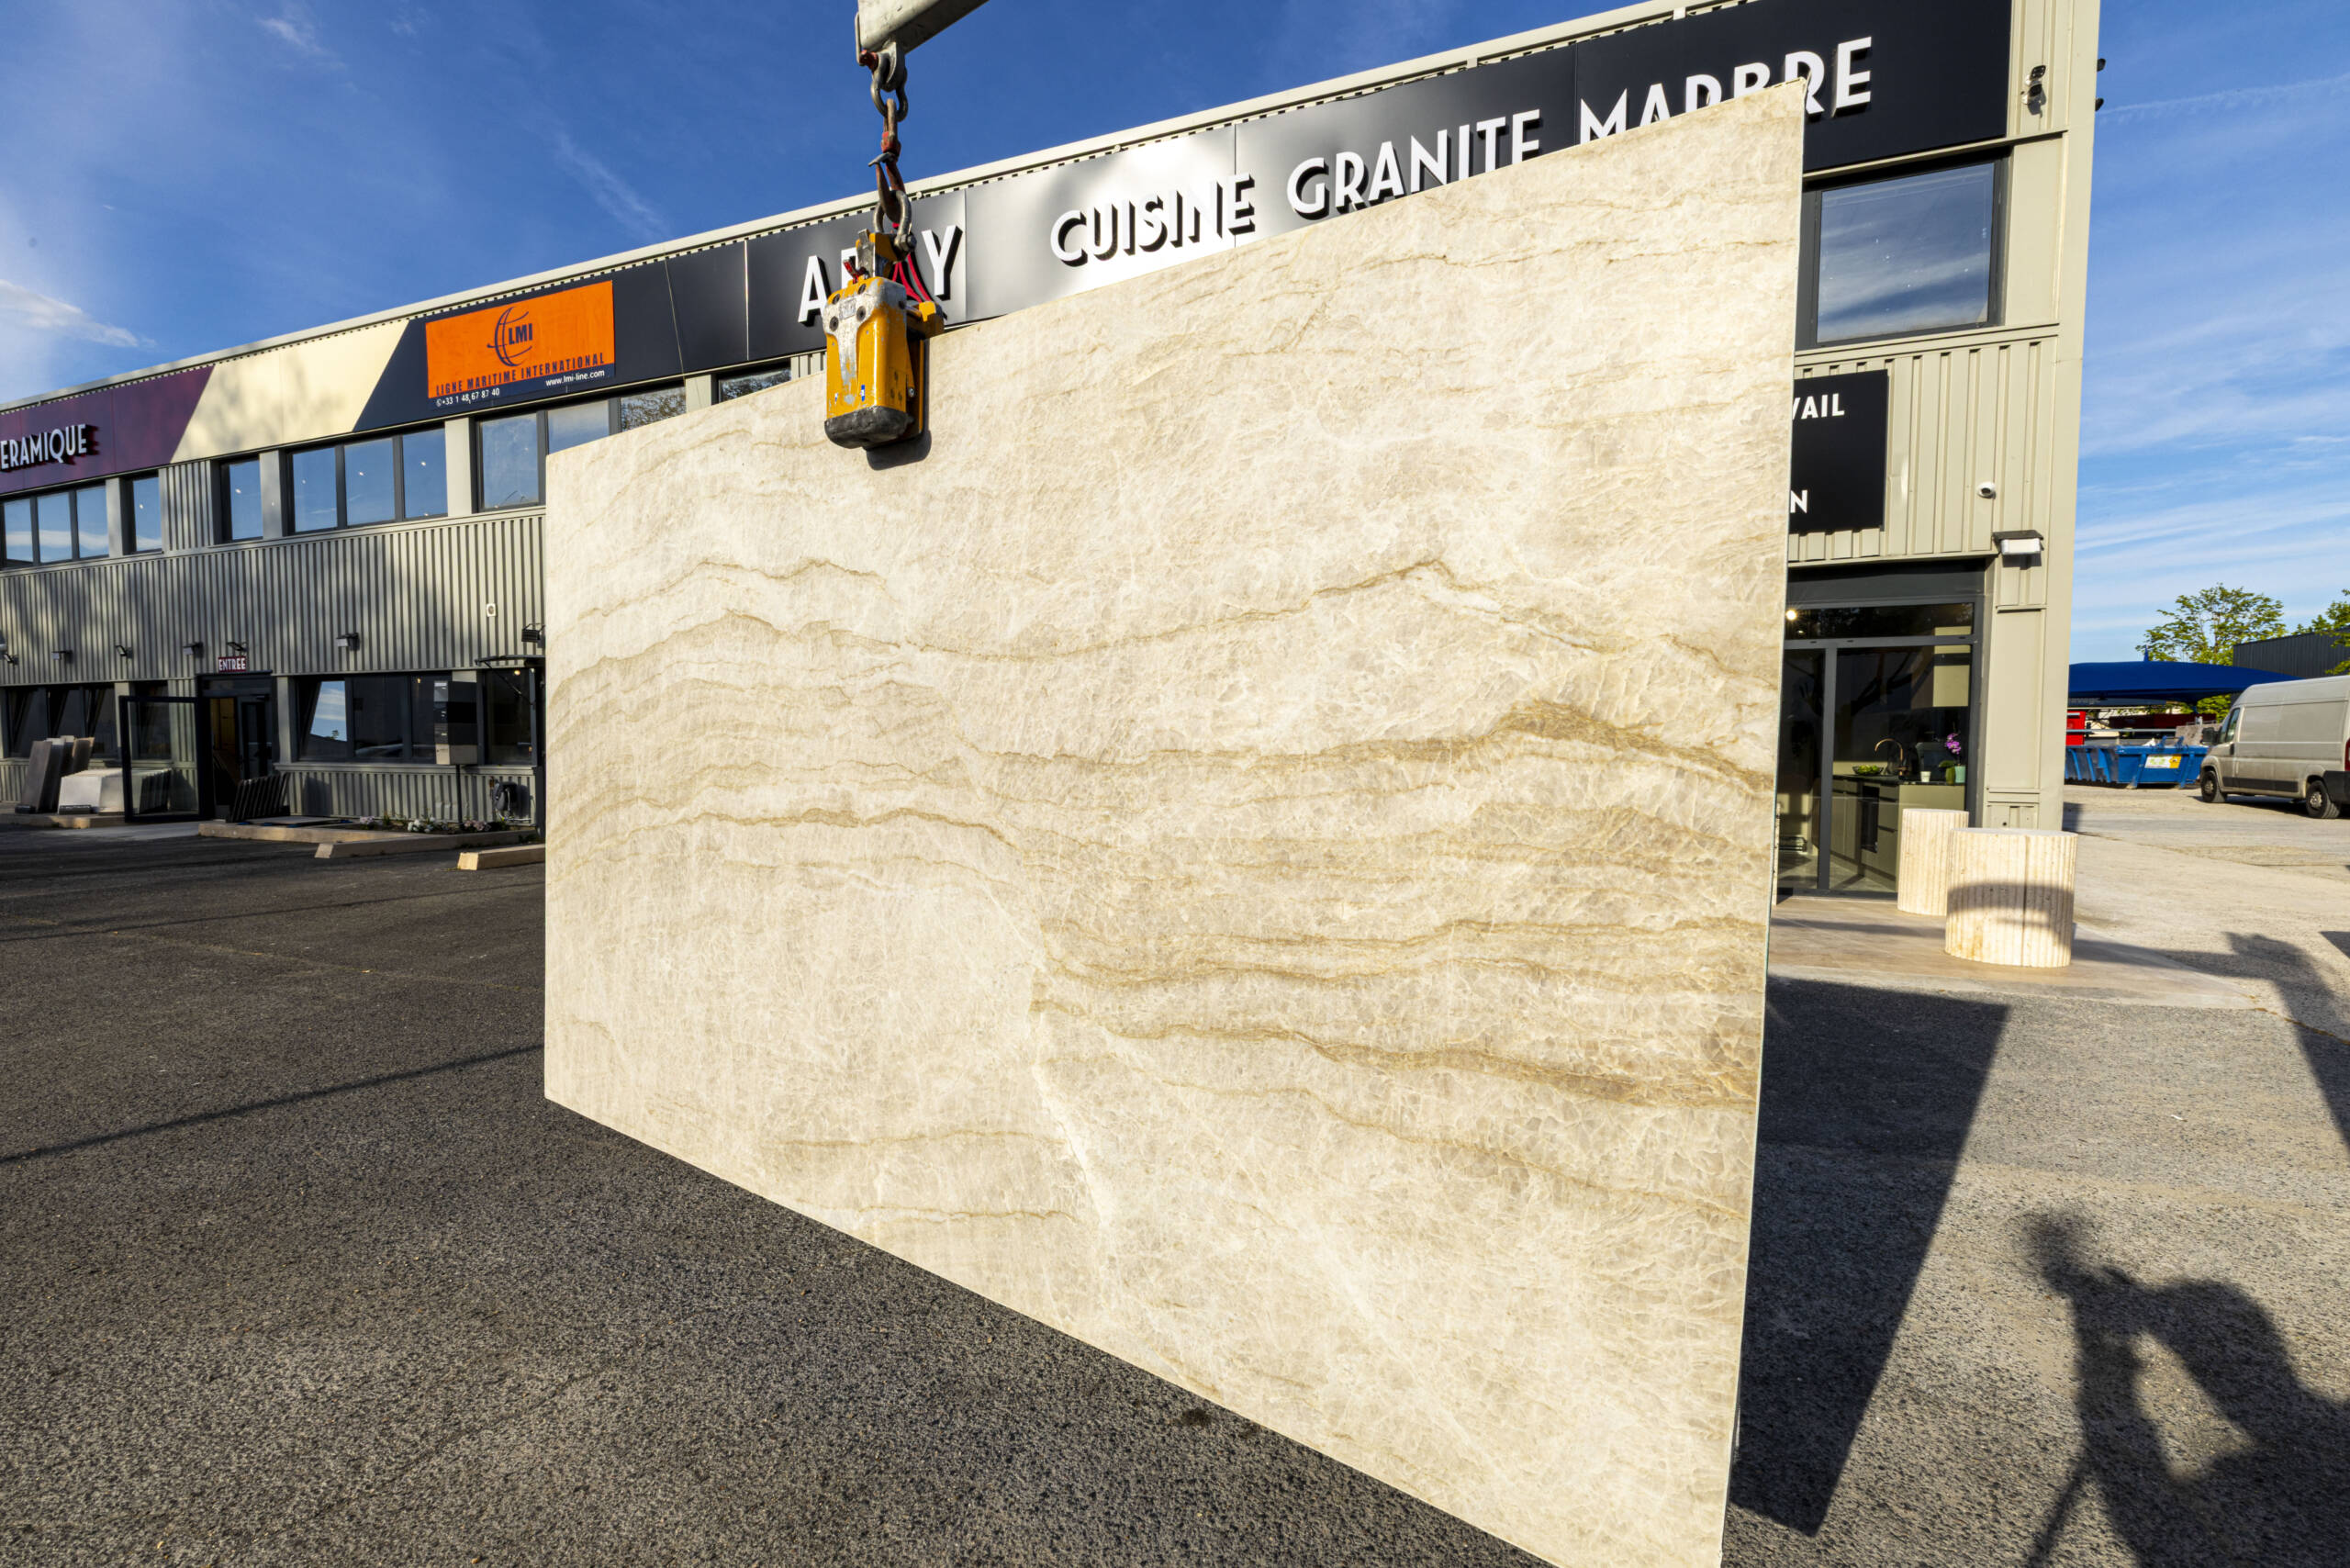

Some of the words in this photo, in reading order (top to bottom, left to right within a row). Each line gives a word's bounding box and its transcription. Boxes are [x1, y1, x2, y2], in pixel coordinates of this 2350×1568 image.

[798, 225, 964, 327] AY
[1050, 173, 1256, 267] CUISINE
[1287, 109, 1539, 219] GRANITE
[508, 323, 532, 345] LMI
[436, 380, 463, 396] LIGNE
[467, 369, 516, 390] MARITIME
[521, 353, 604, 378] INTERNATIONAL
[545, 369, 605, 386] www.lmi-line.com
[461, 393, 469, 402] 48
[471, 391, 479, 400] 67
[481, 389, 489, 398] 87
[491, 387, 500, 396] 40
[218, 657, 246, 671] ENTREE
